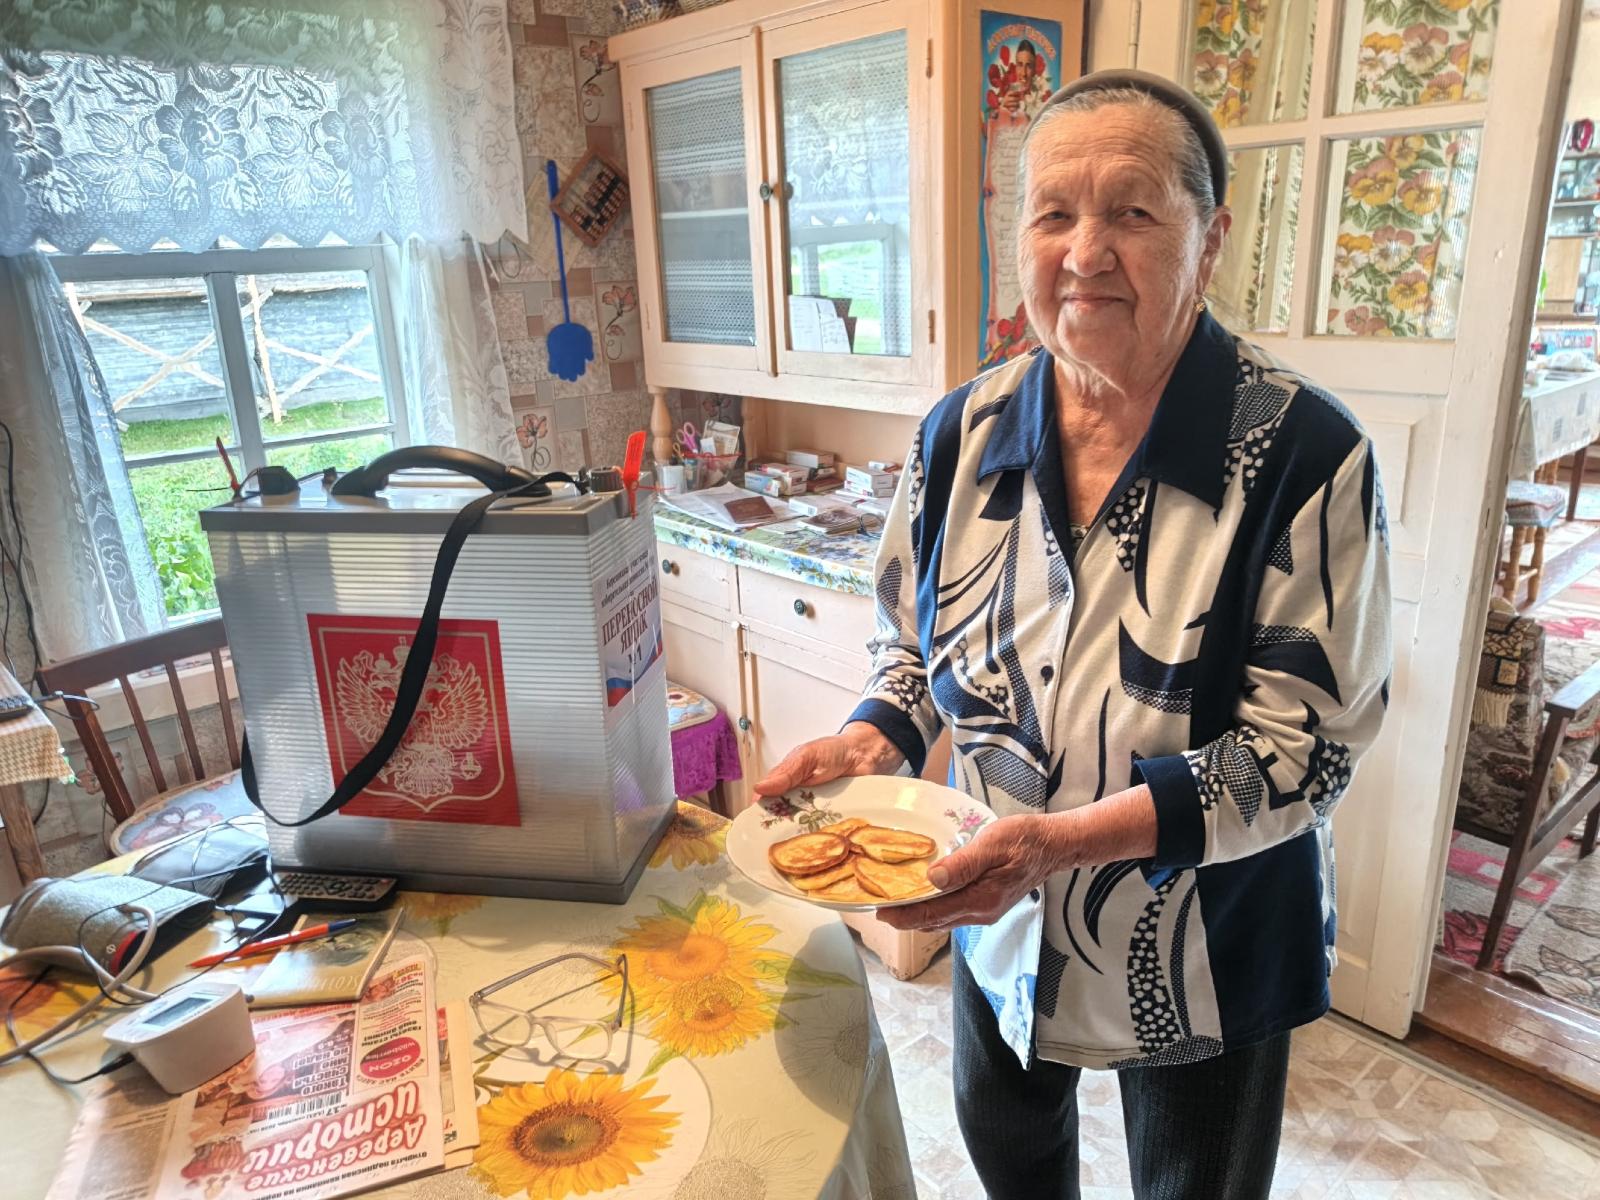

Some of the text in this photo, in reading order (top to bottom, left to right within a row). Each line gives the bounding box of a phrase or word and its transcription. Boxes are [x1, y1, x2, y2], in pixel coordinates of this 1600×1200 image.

[602, 576, 658, 646] ПЕРЕНОСНОЙ
[301, 1077, 346, 1095] Такого
[367, 1054, 412, 1072] OZON
[244, 1080, 416, 1173] истории
[244, 1114, 424, 1192] Деревенские
